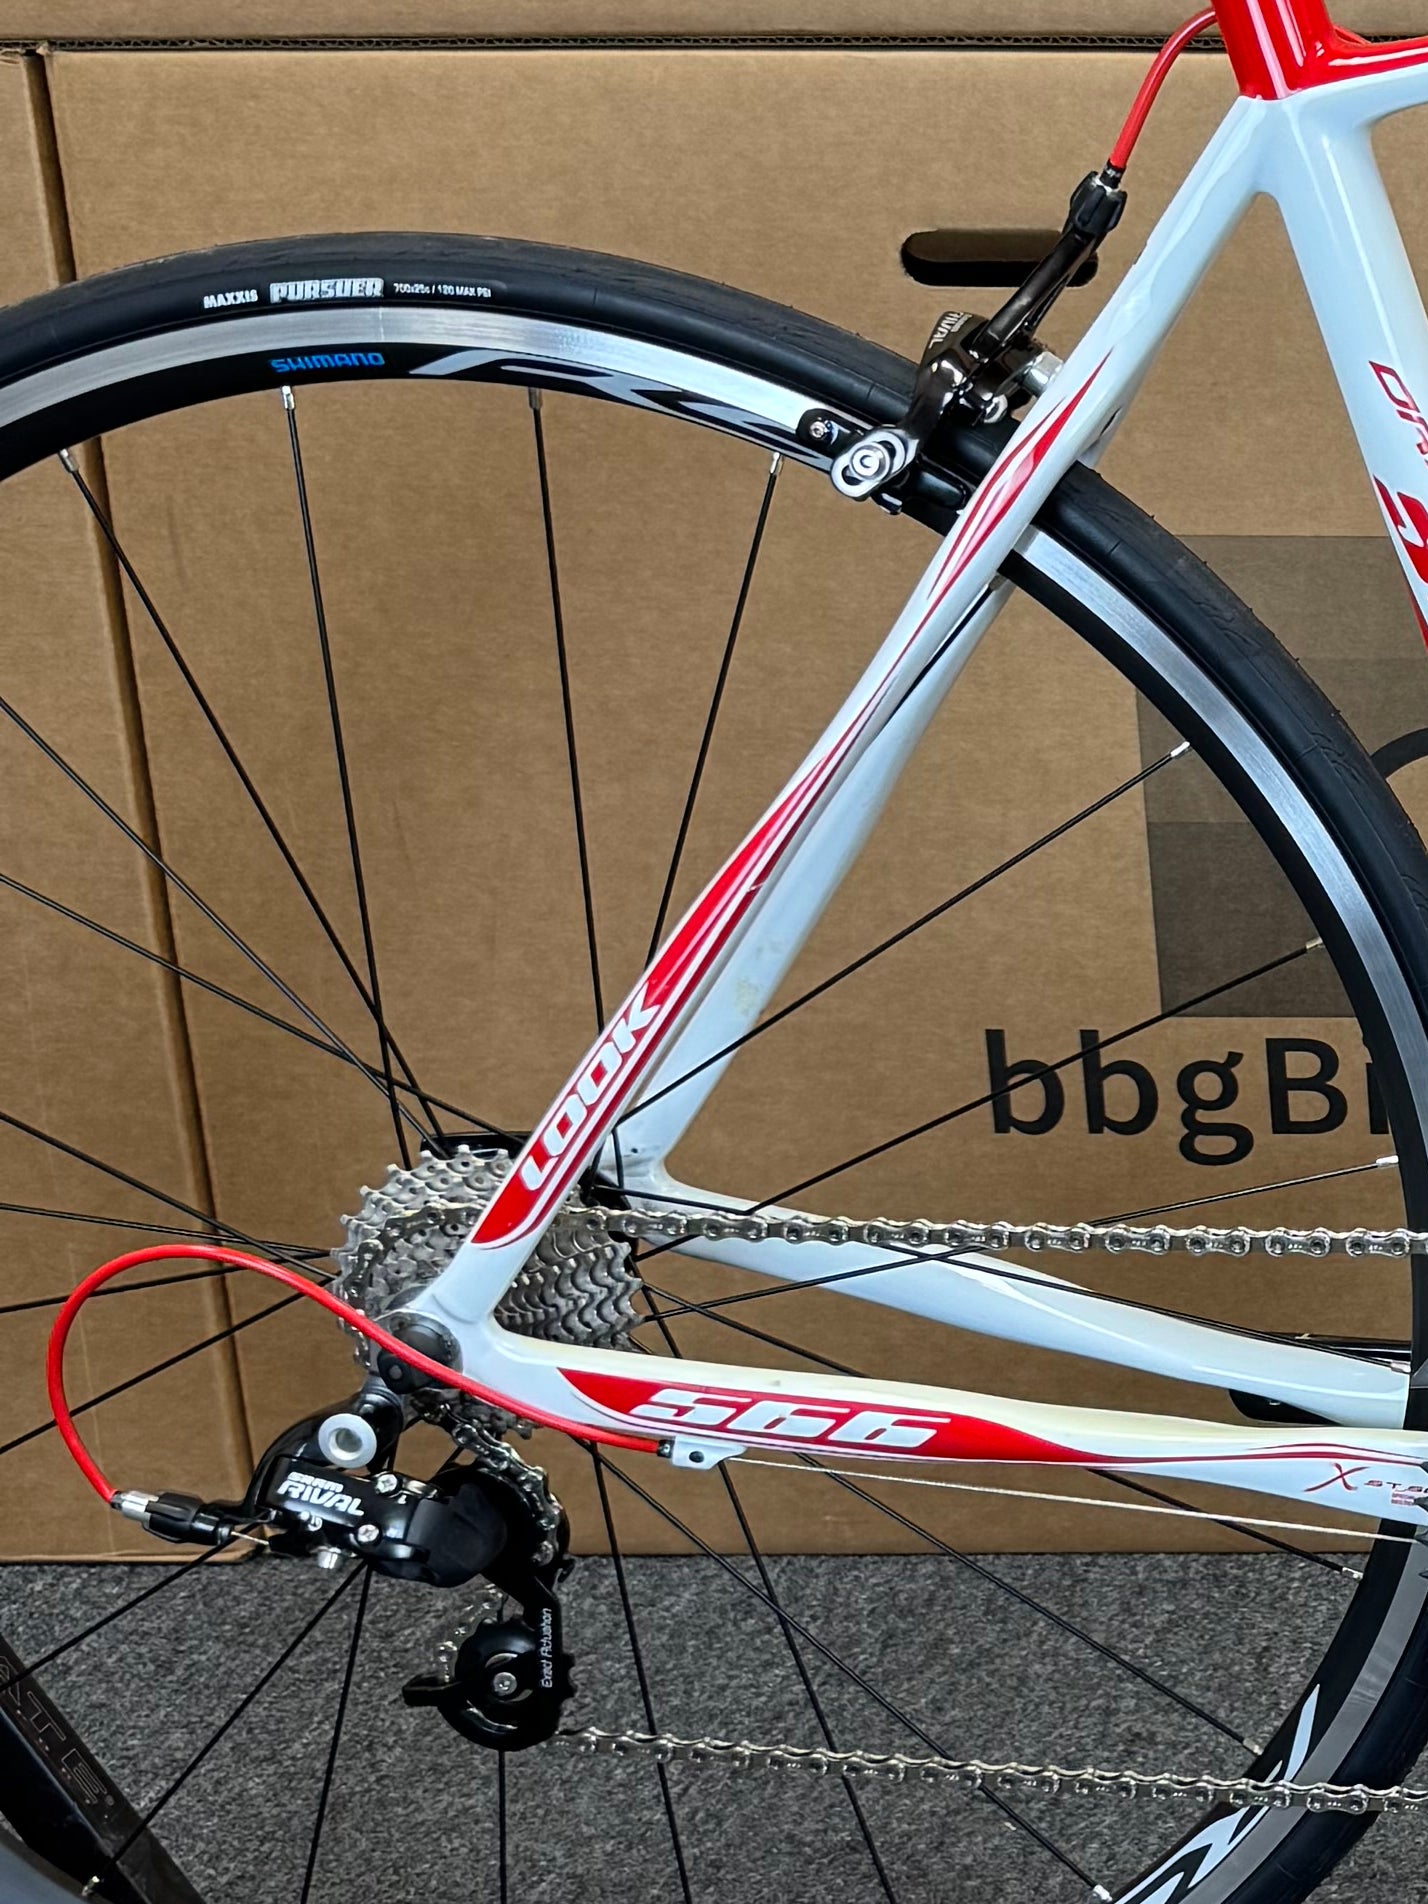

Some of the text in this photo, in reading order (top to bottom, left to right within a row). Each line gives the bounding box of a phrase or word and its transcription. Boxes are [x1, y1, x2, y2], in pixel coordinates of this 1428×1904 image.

[203, 289, 258, 309] MAXXIS
[269, 277, 384, 304] PURSUER
[270, 352, 385, 373] SHIMANO
[520, 980, 661, 1192] LOOK
[629, 1388, 952, 1448] 566
[276, 1479, 364, 1516] RIVAL
